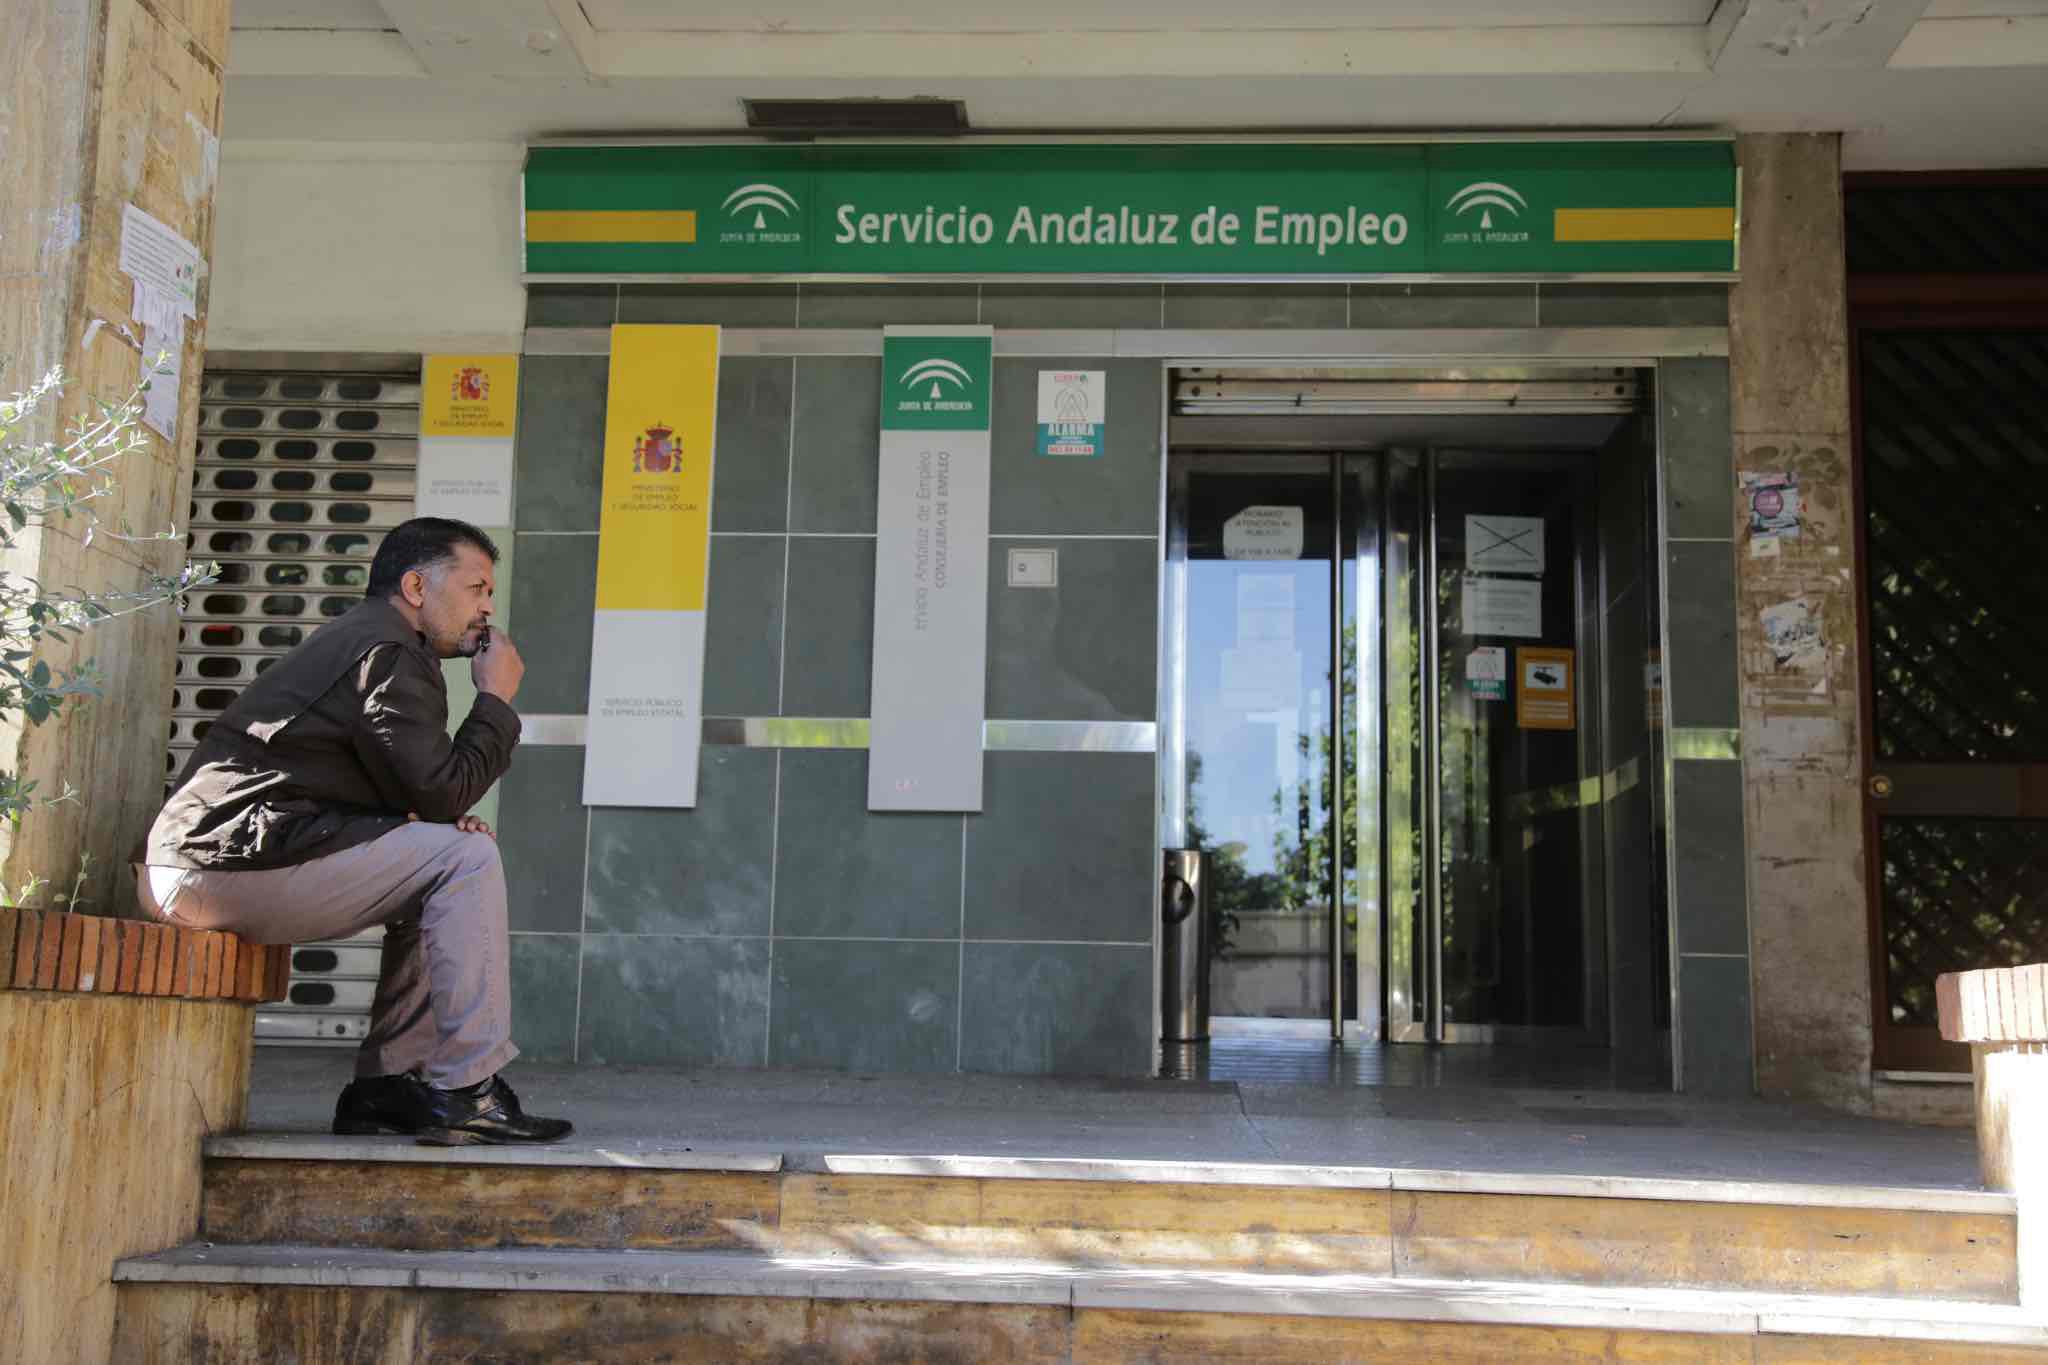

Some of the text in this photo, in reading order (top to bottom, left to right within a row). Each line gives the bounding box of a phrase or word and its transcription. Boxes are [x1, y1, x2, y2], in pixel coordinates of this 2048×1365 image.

[835, 205, 1408, 256] Servicio Andaluz de Empleo
[915, 451, 934, 500] Empleo
[936, 451, 950, 497] EMPLEO
[916, 503, 931, 522] de
[936, 502, 948, 516] DE
[914, 527, 930, 582] Andaluz
